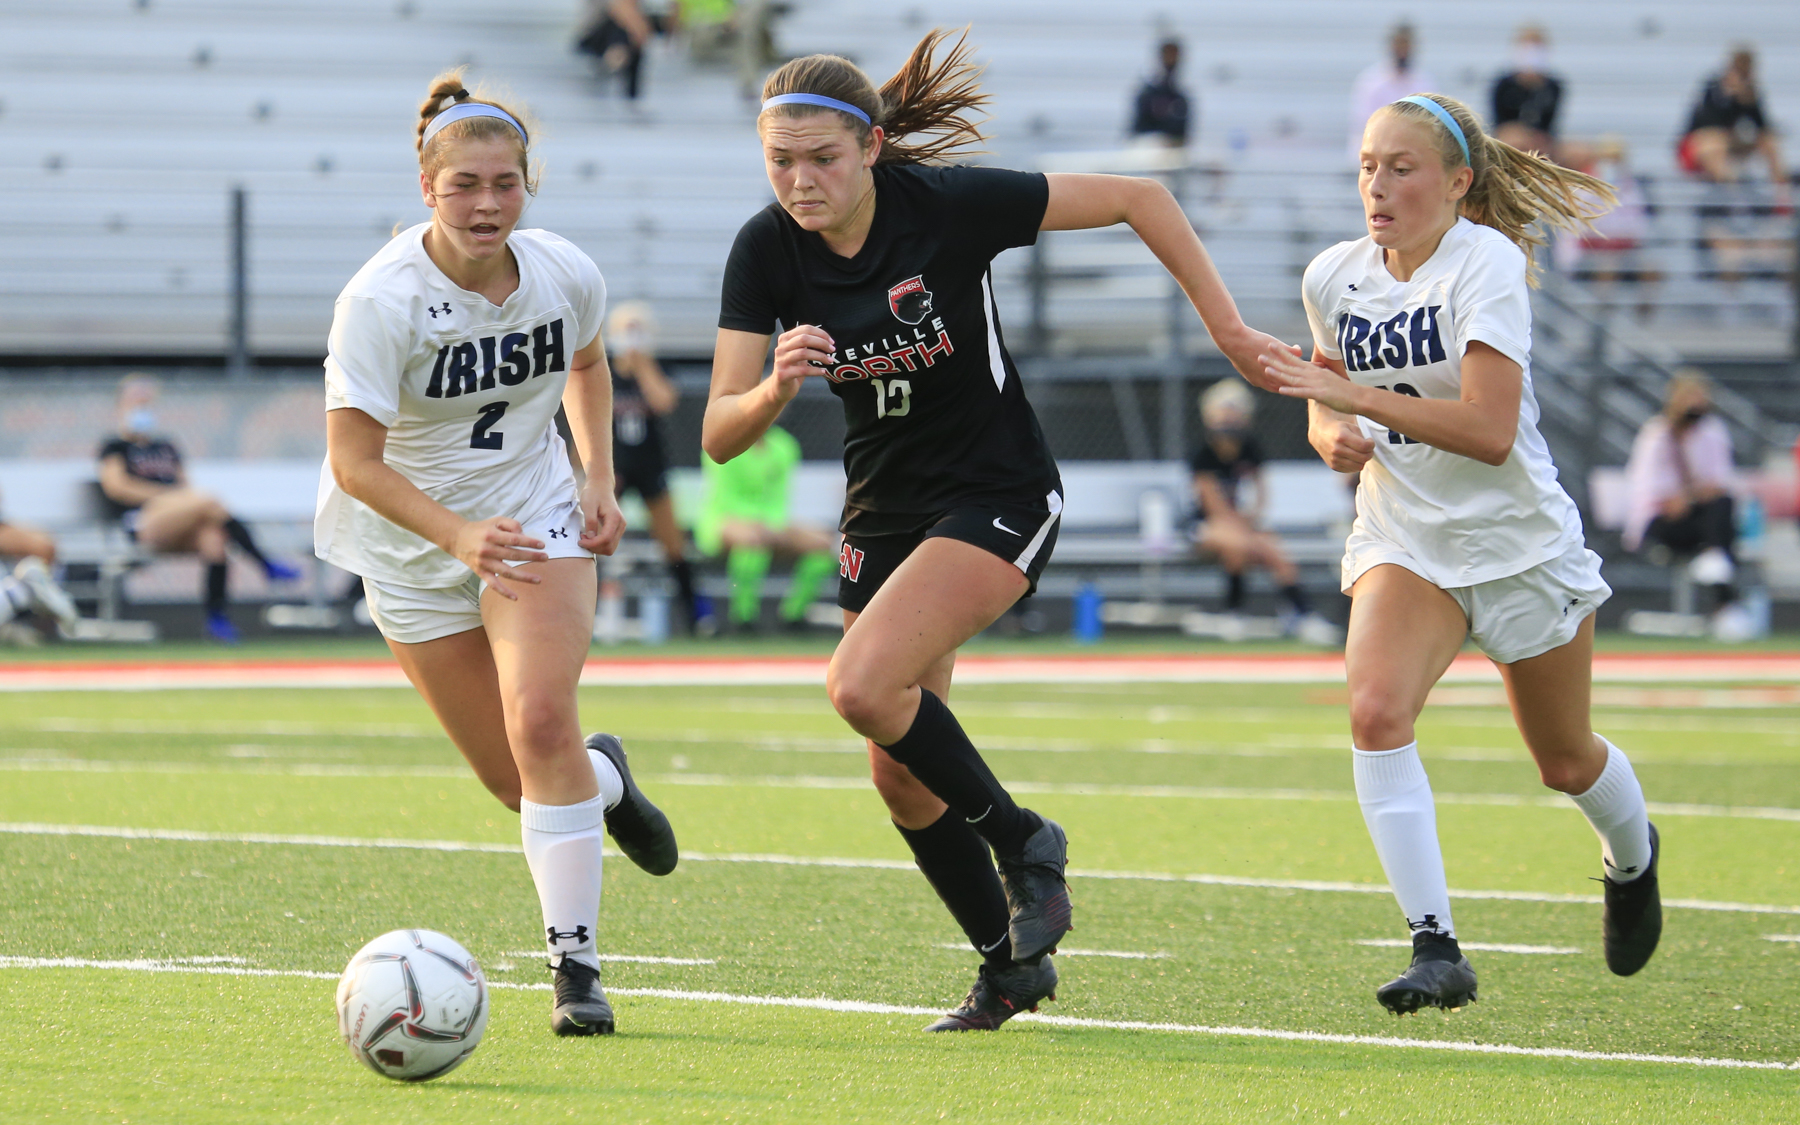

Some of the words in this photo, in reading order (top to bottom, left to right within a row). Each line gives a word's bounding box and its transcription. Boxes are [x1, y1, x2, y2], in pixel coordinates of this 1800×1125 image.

[890, 280, 921, 298] PANTHERS
[425, 318, 565, 398] IRISH
[813, 317, 945, 366] KEVILLE
[1338, 305, 1447, 372] IRISH
[469, 401, 510, 450] 2
